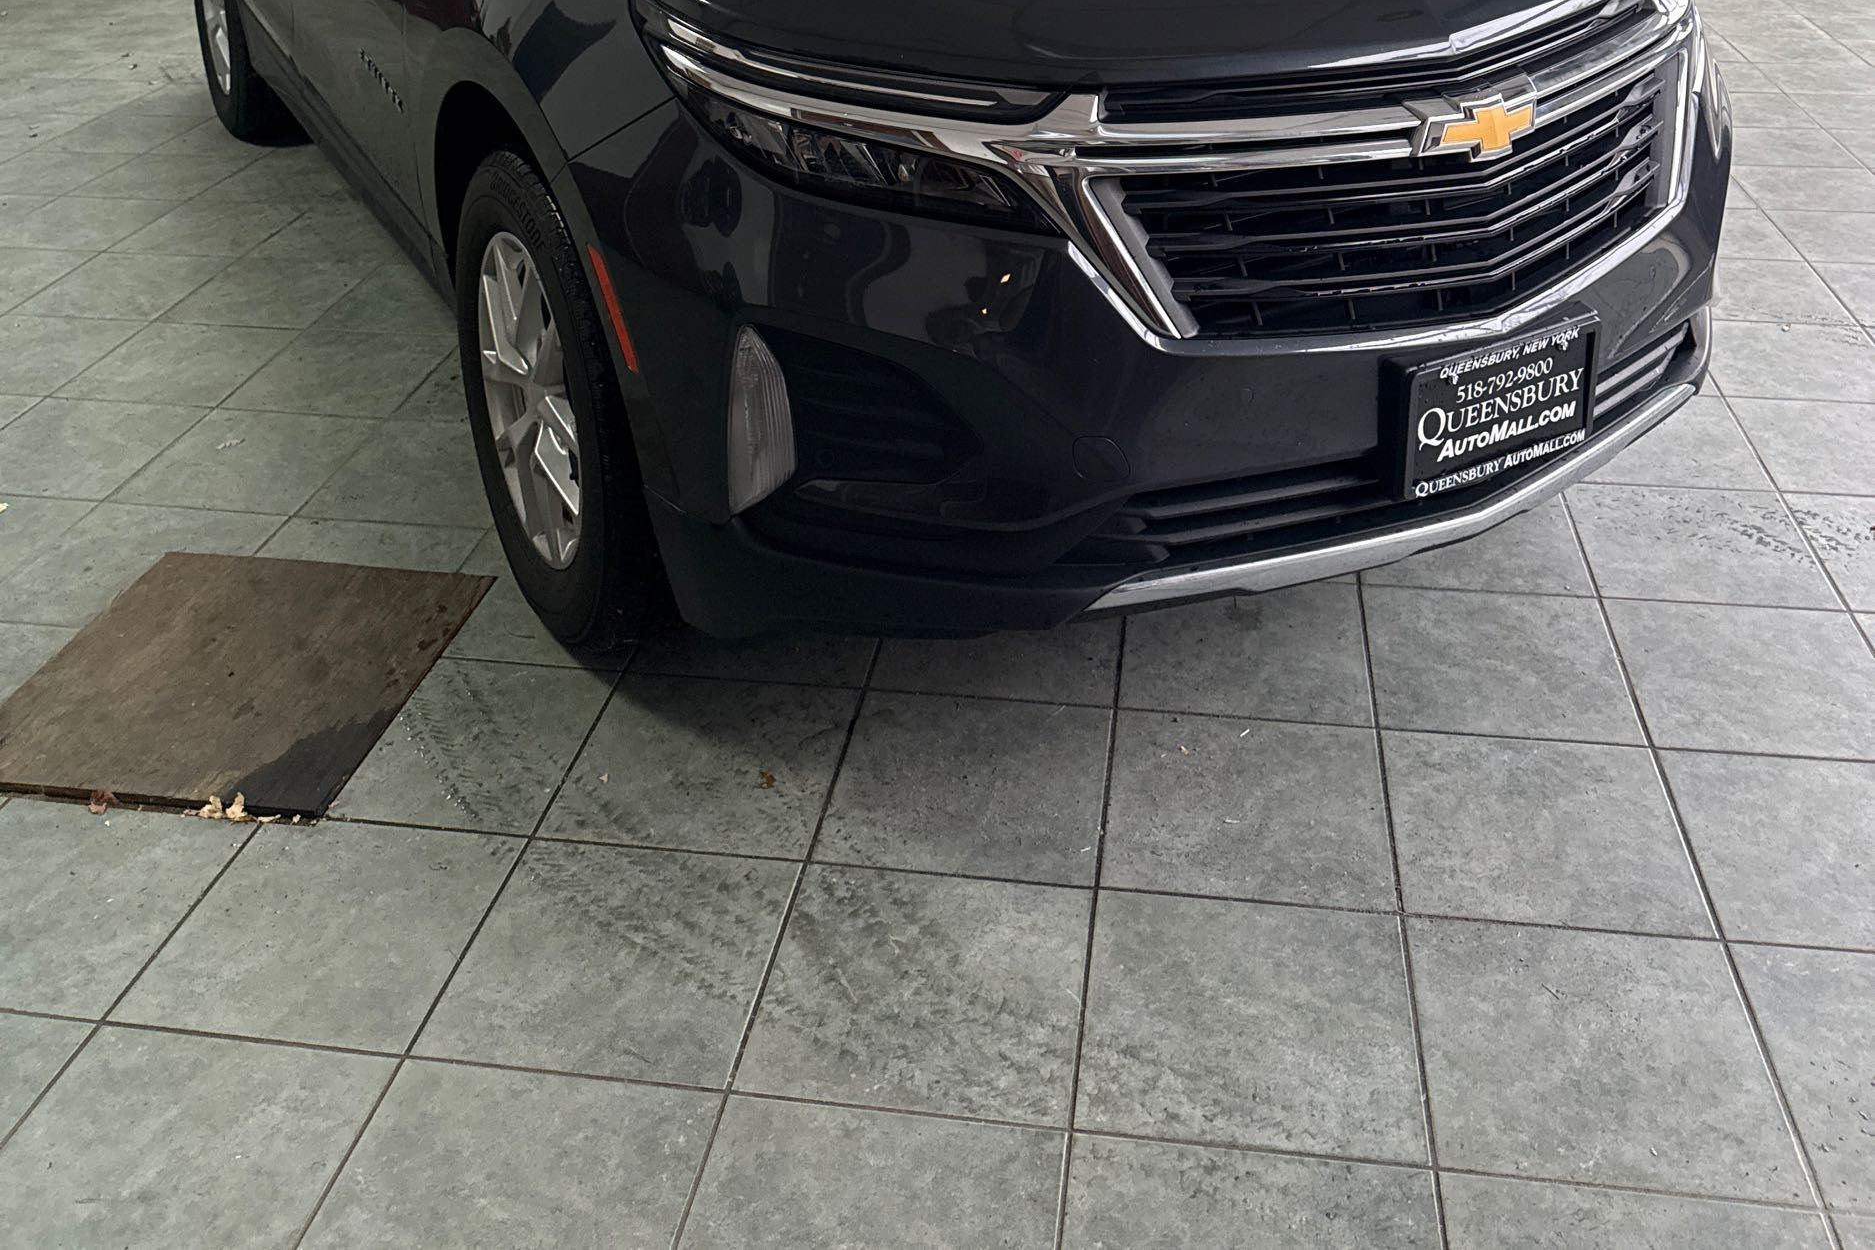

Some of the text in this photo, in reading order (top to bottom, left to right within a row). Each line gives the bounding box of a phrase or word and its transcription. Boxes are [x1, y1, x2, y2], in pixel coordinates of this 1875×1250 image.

[1522, 336, 1552, 355] NEW
[1551, 327, 1580, 344] YORK
[1456, 358, 1553, 403] 518-792-9800
[1417, 368, 1584, 451] QUEENSBURY
[1415, 459, 1500, 498] QUEENSBURY
